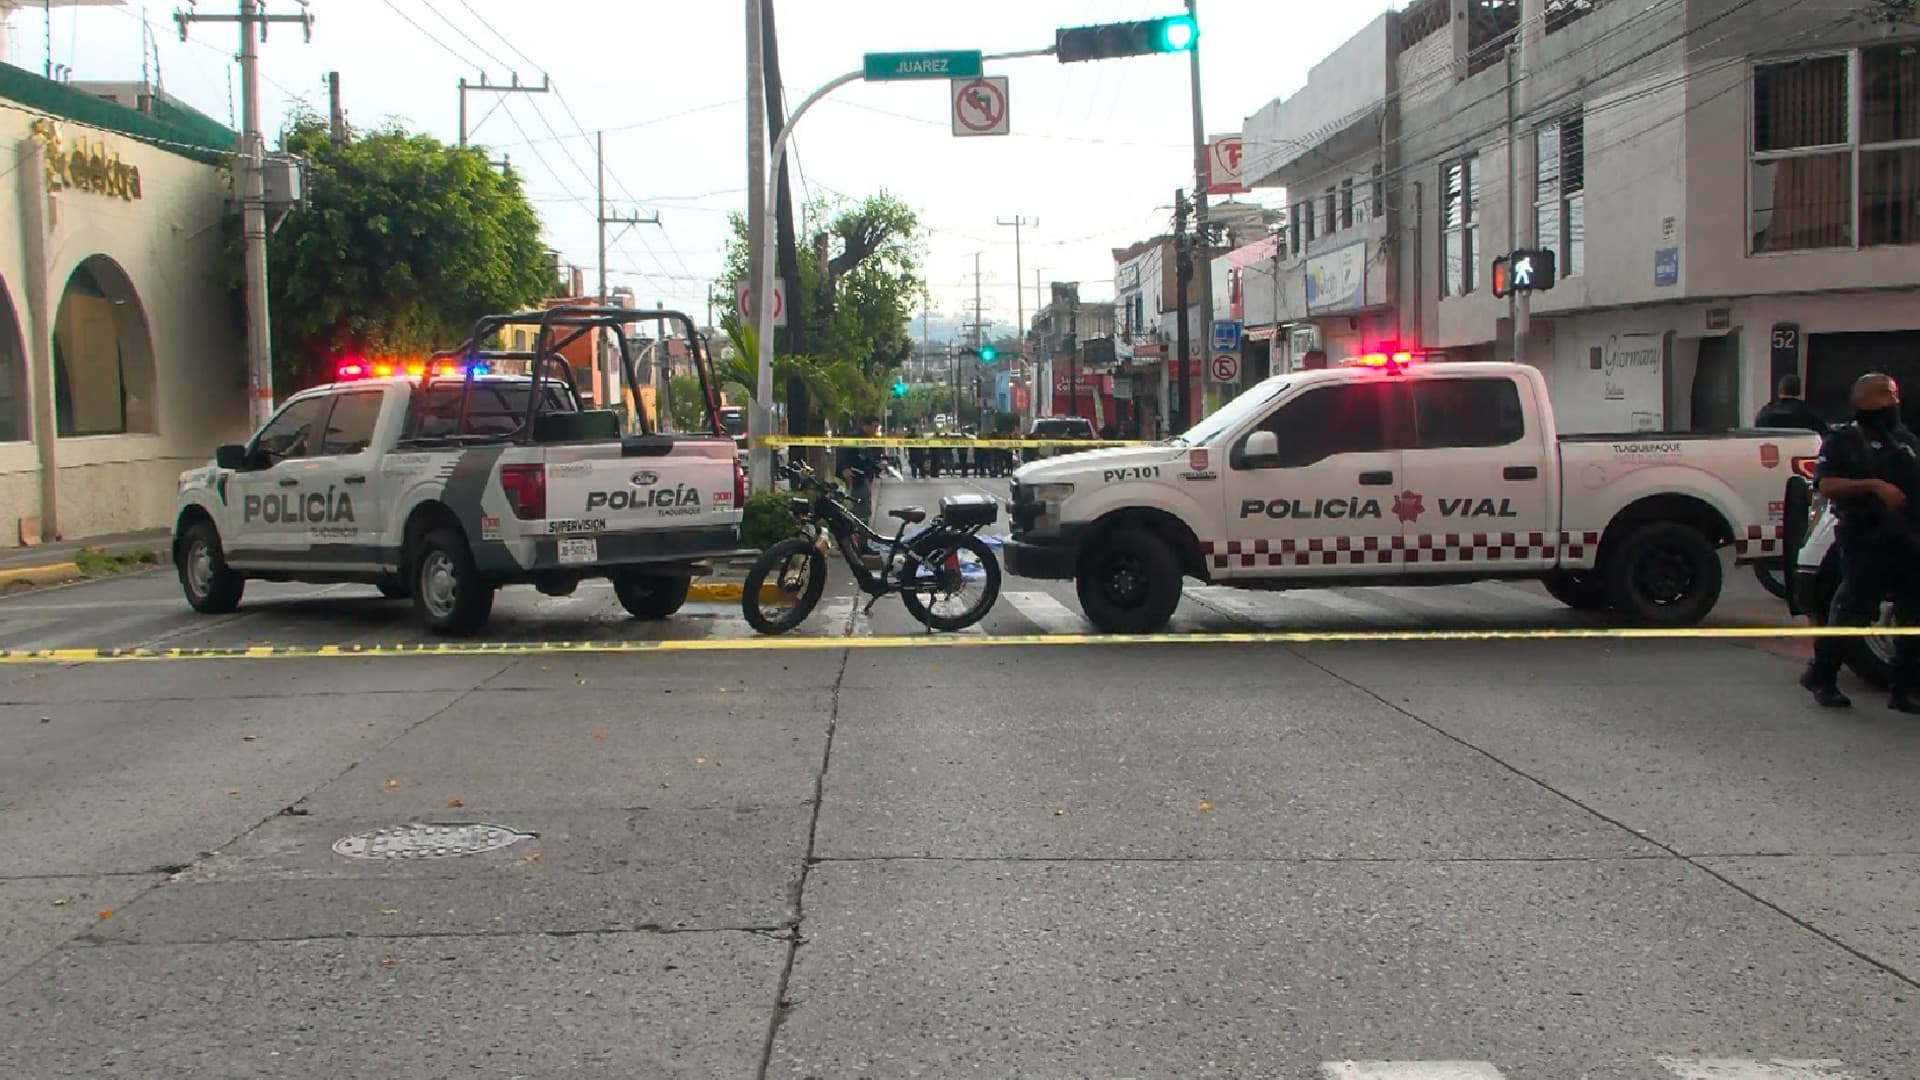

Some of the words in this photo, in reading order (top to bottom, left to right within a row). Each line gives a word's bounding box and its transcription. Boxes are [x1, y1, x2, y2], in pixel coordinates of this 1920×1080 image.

[896, 59, 949, 73] JUAREZ
[1773, 330, 1796, 349] 52
[1103, 465, 1160, 482] PV-101
[244, 484, 355, 523] POLICÍA
[586, 483, 701, 512] POLICÍA
[1437, 498, 1518, 518] VIAL
[548, 518, 606, 533] SUPERVISION
